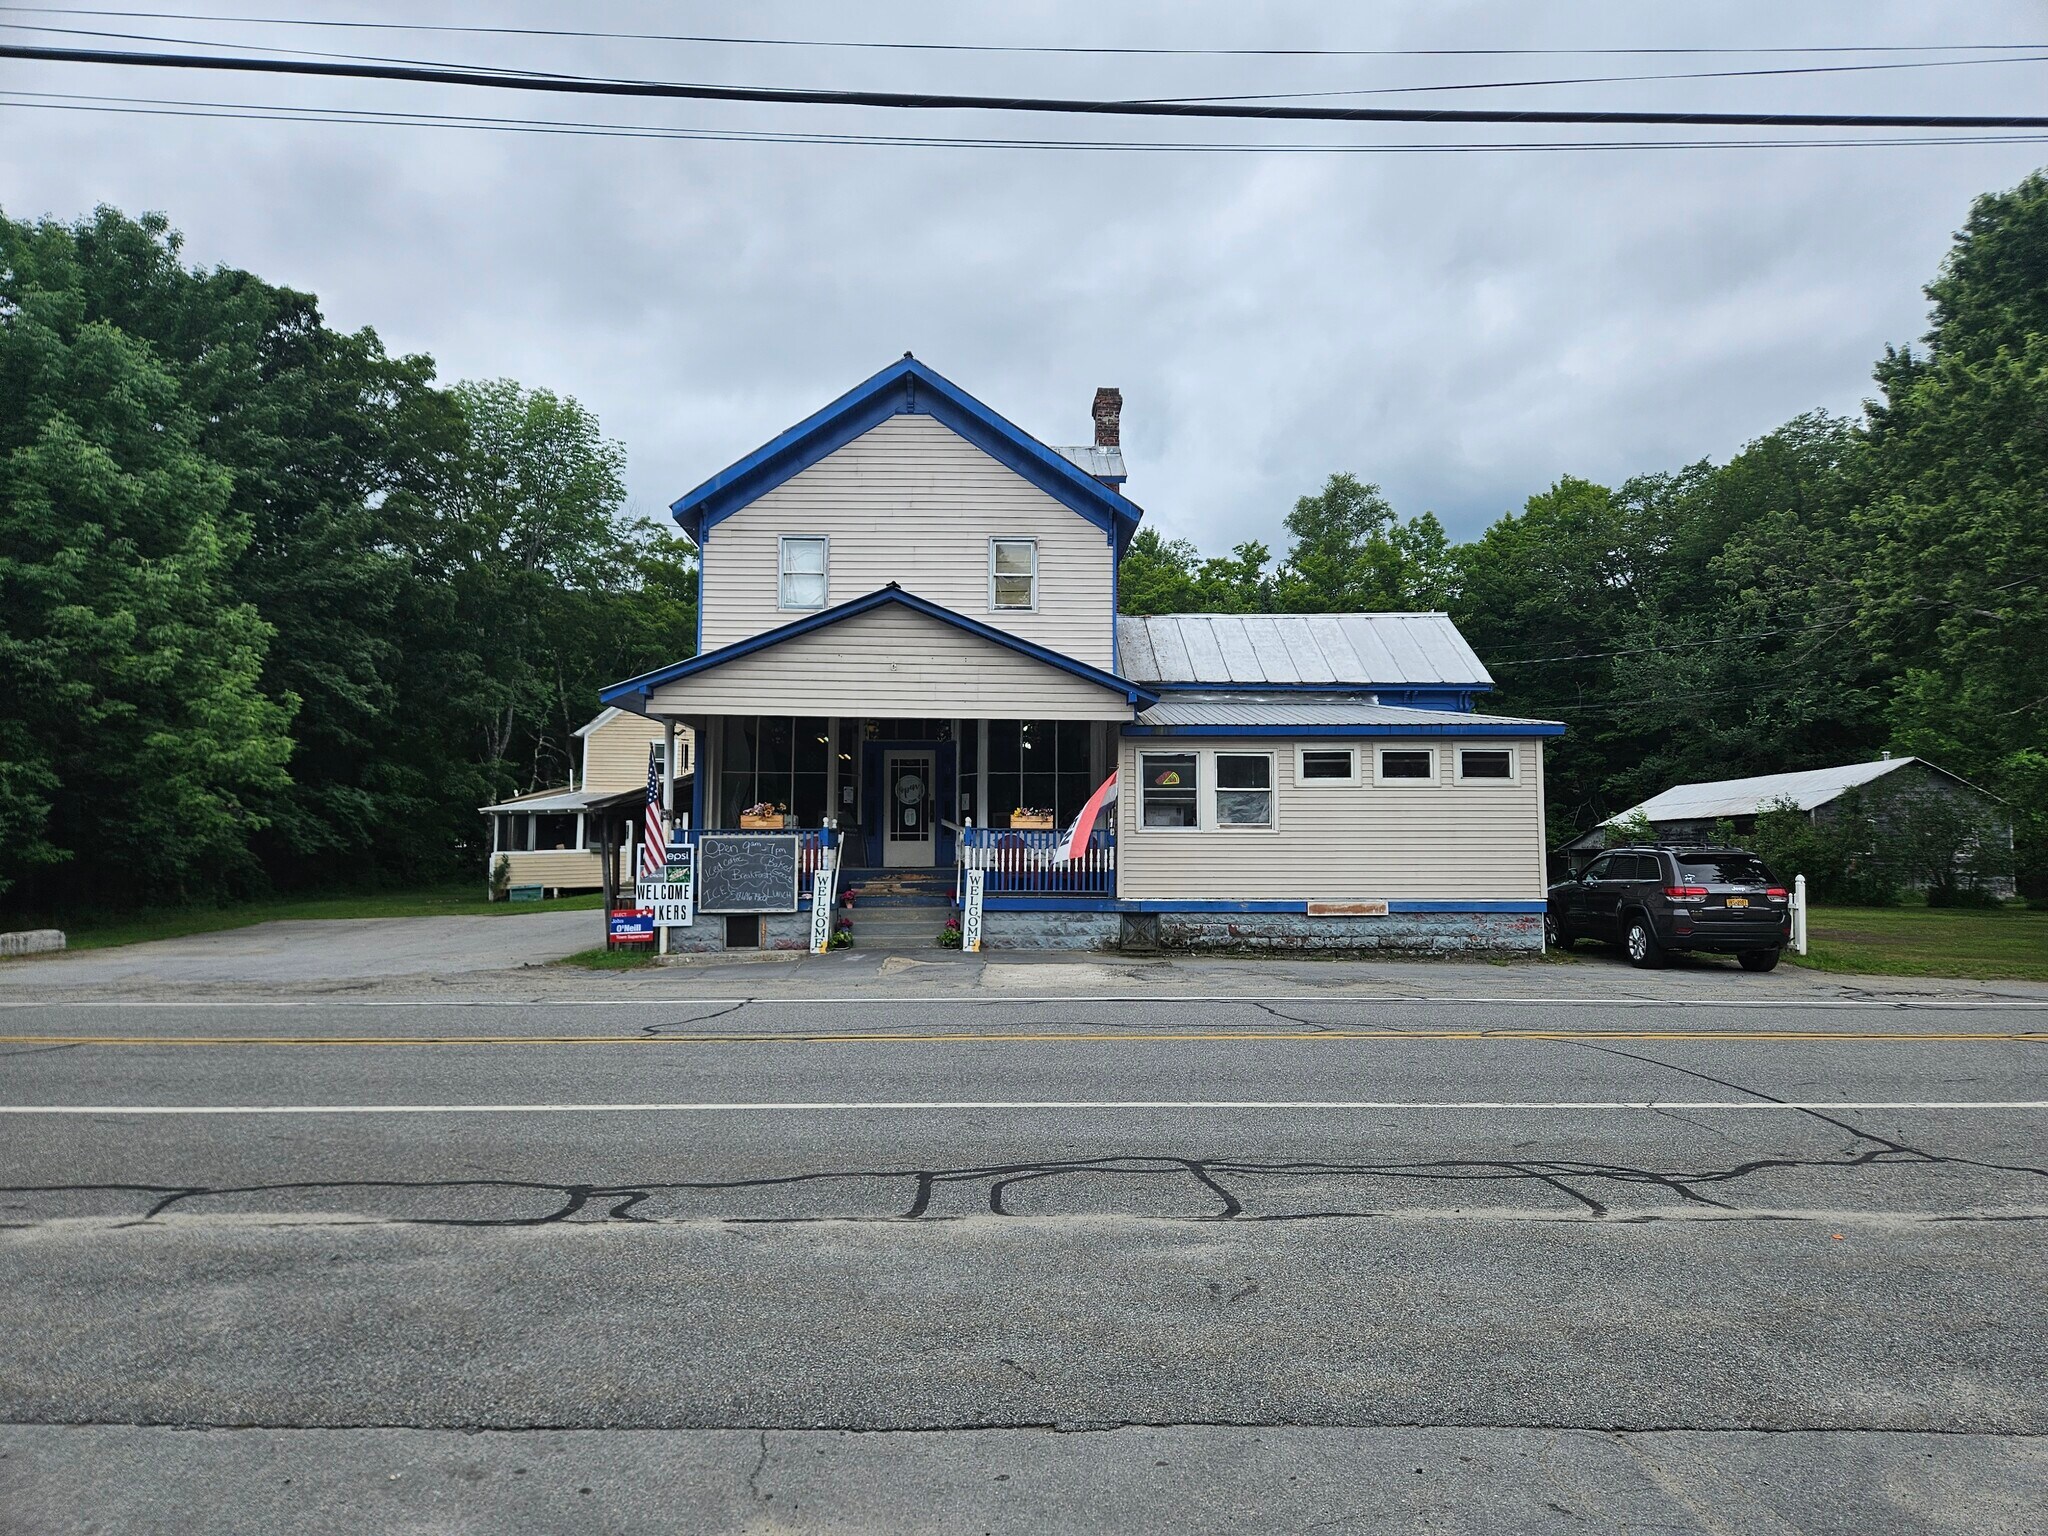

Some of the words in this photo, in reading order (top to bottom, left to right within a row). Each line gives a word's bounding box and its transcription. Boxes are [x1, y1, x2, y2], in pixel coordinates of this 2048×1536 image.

[705, 840, 738, 855] Open
[667, 851, 689, 861] epsi
[637, 884, 690, 900] WELCOME
[814, 876, 829, 948] WELCOME
[967, 875, 981, 947] WELCOME
[616, 923, 641, 932] O'Neill
